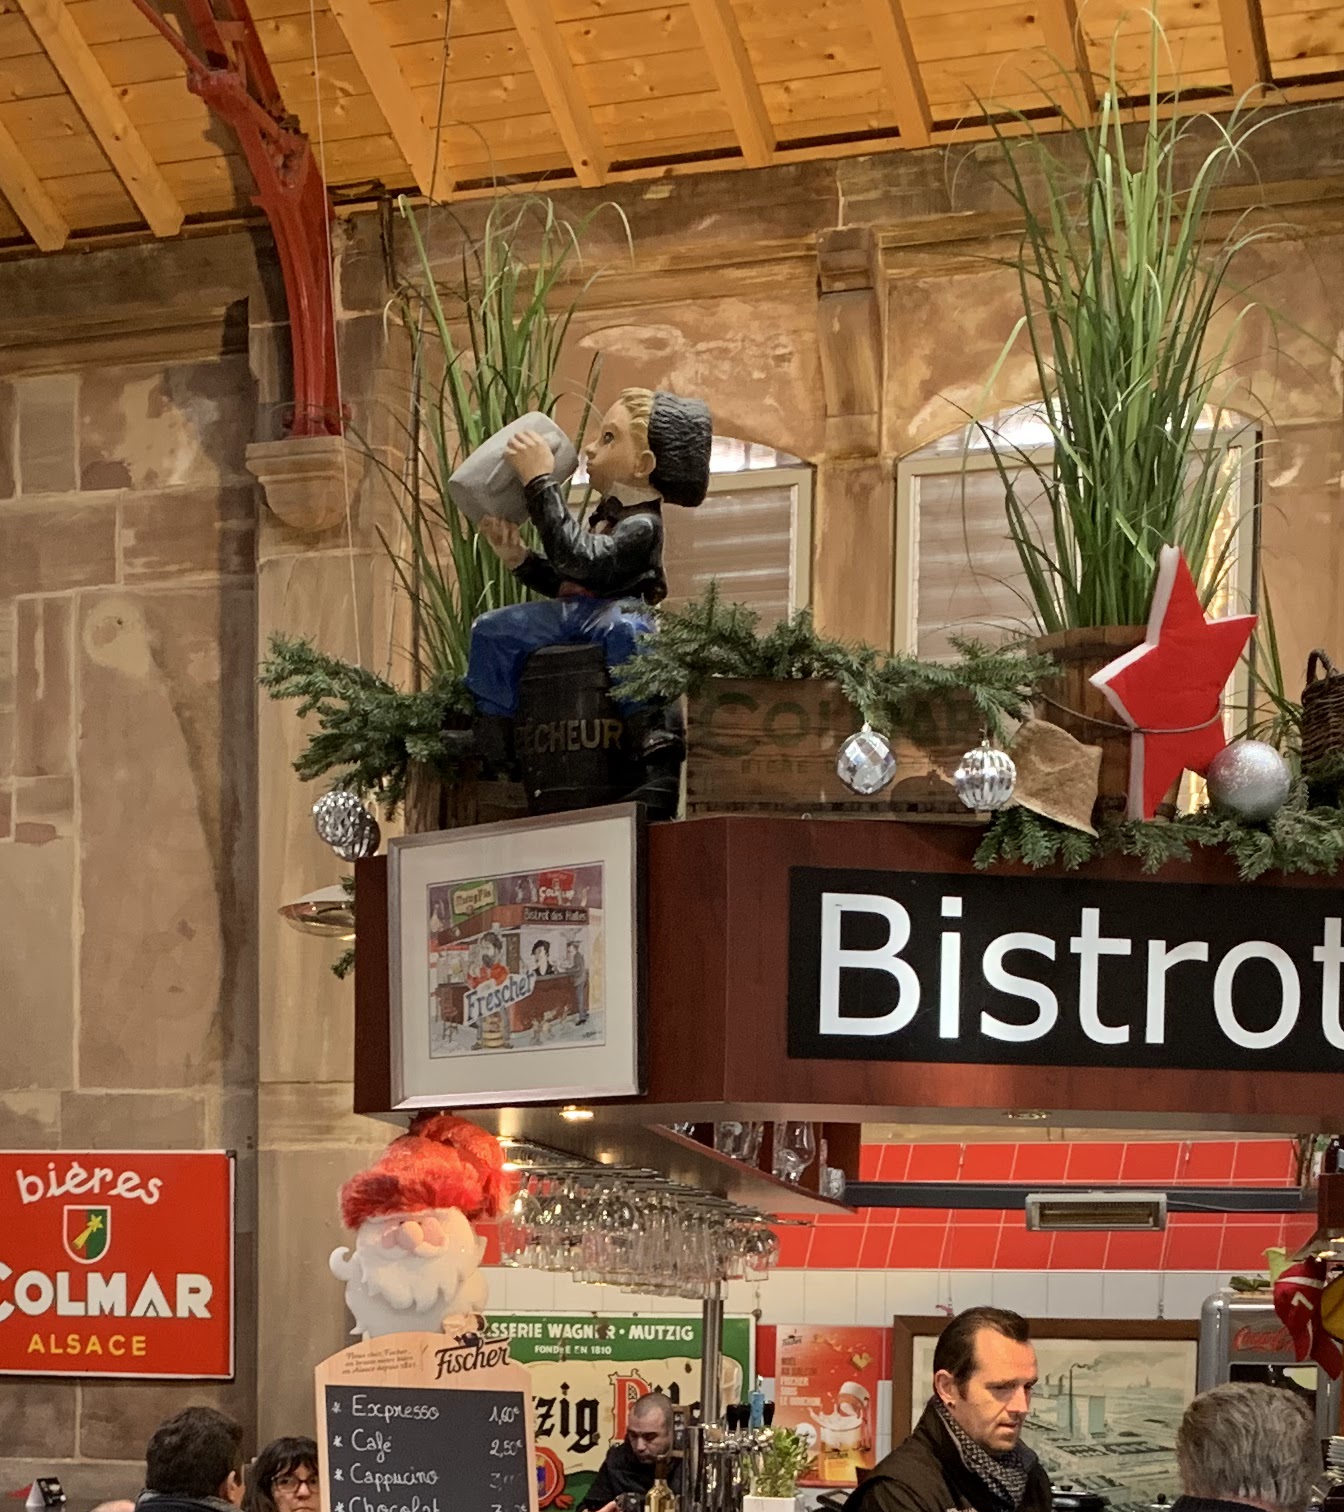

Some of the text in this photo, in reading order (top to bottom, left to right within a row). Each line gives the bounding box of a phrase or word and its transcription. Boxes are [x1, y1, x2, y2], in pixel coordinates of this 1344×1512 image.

[465, 971, 536, 1021] Frescher
[16, 1162, 163, 1204] bières
[27, 1333, 147, 1356] ALSACE
[628, 1325, 694, 1341] MUTZIG
[434, 1345, 511, 1381] Fischer
[591, 1346, 612, 1355] 1810
[352, 1394, 440, 1424] Expresso
[532, 1382, 602, 1454] zig
[351, 1428, 392, 1463] Café
[350, 1463, 440, 1493] Cappucino
